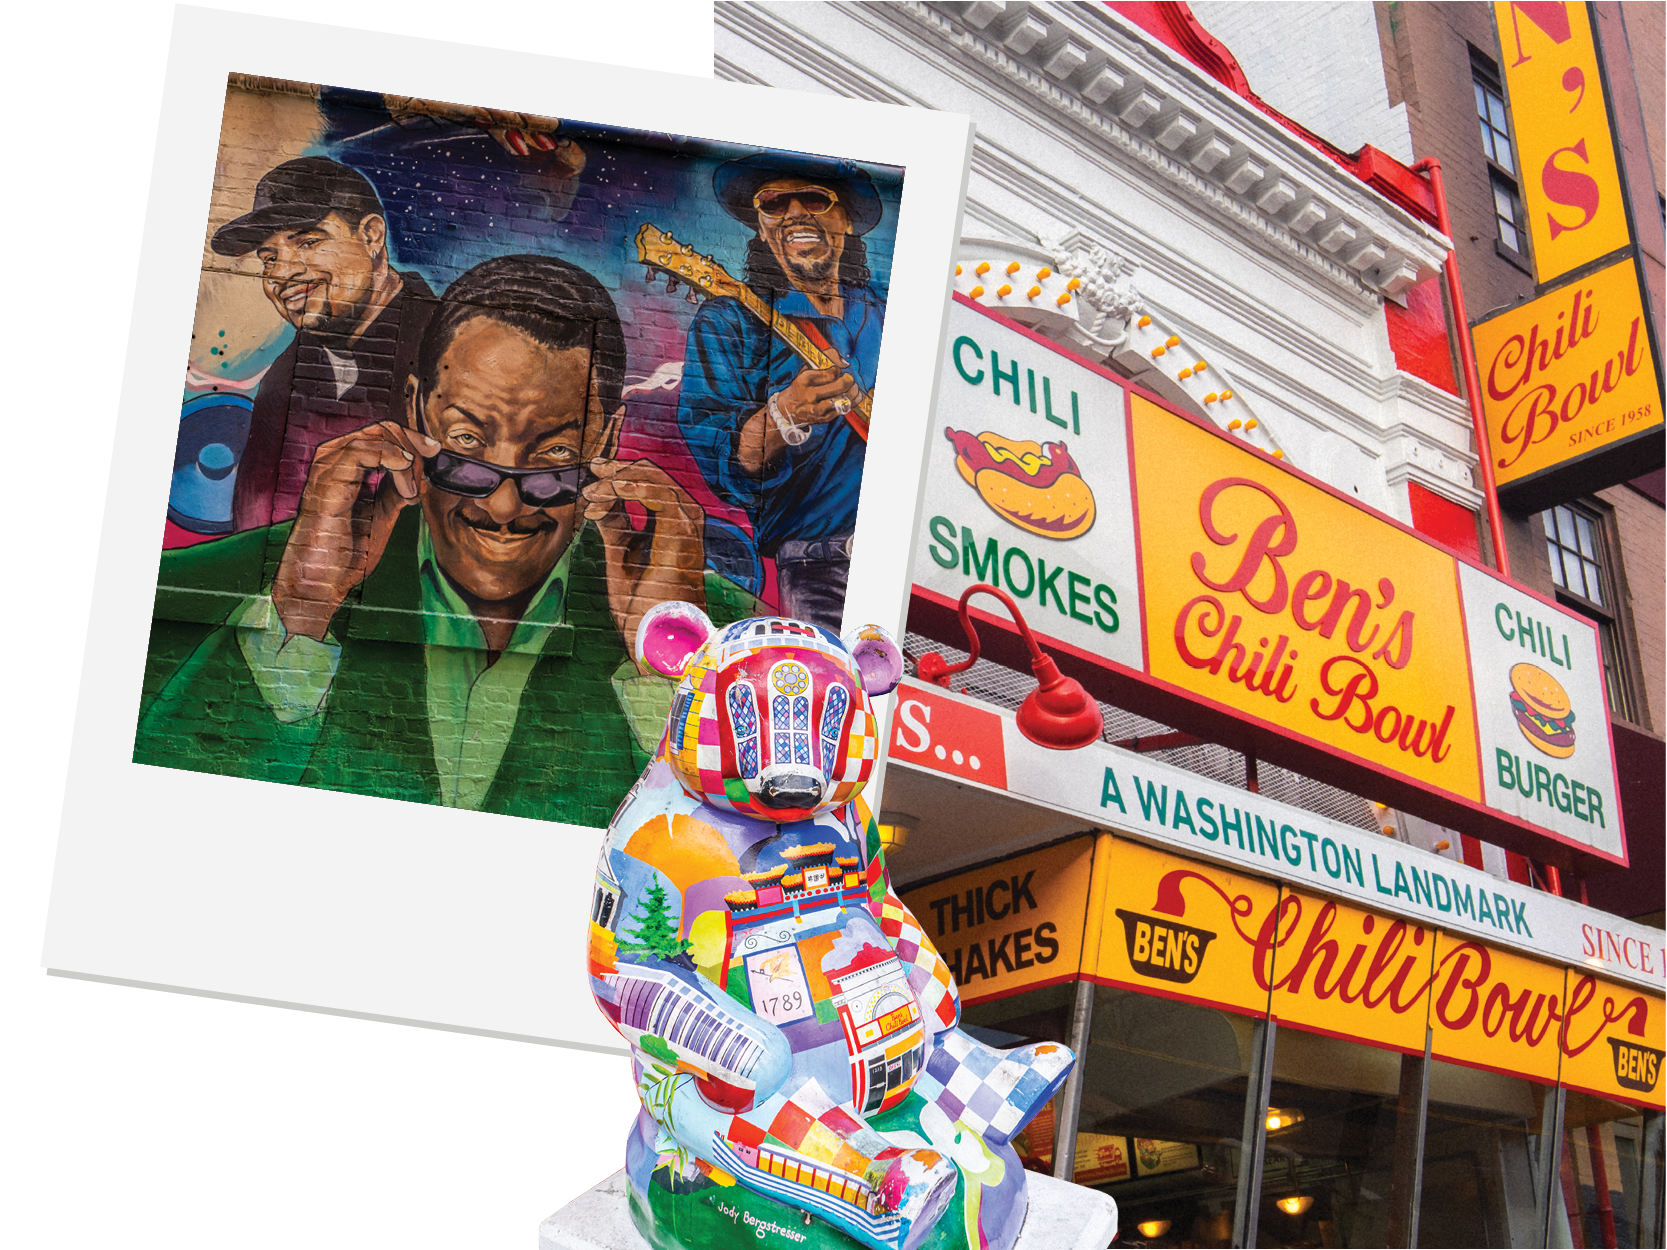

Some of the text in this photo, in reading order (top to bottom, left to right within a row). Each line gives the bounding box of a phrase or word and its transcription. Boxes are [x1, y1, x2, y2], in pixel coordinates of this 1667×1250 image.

[1487, 289, 1599, 401] Chili
[952, 335, 1081, 435] CHILI
[1498, 317, 1645, 469] Bowl
[1569, 404, 1652, 447] SINCE 1958
[928, 515, 1120, 633] SMOKES
[1190, 477, 1416, 670] Ben's
[1494, 602, 1573, 671] CHILI
[1174, 594, 1456, 763] Chili Bowl
[895, 694, 981, 770] S...
[1495, 748, 1606, 830] BURGER
[1099, 766, 1534, 939] A WASHINGTON LANDMARK
[929, 869, 1039, 937] THICK
[940, 921, 1060, 987] HAKES
[1132, 921, 1200, 976] BEN'S
[1250, 894, 1610, 1059] Chili Bowl
[1581, 923, 1655, 975] SINCE
[762, 990, 802, 1017] 1789
[1617, 1045, 1658, 1086] BEN'S
[717, 1201, 807, 1243] Jody Bergstresser
